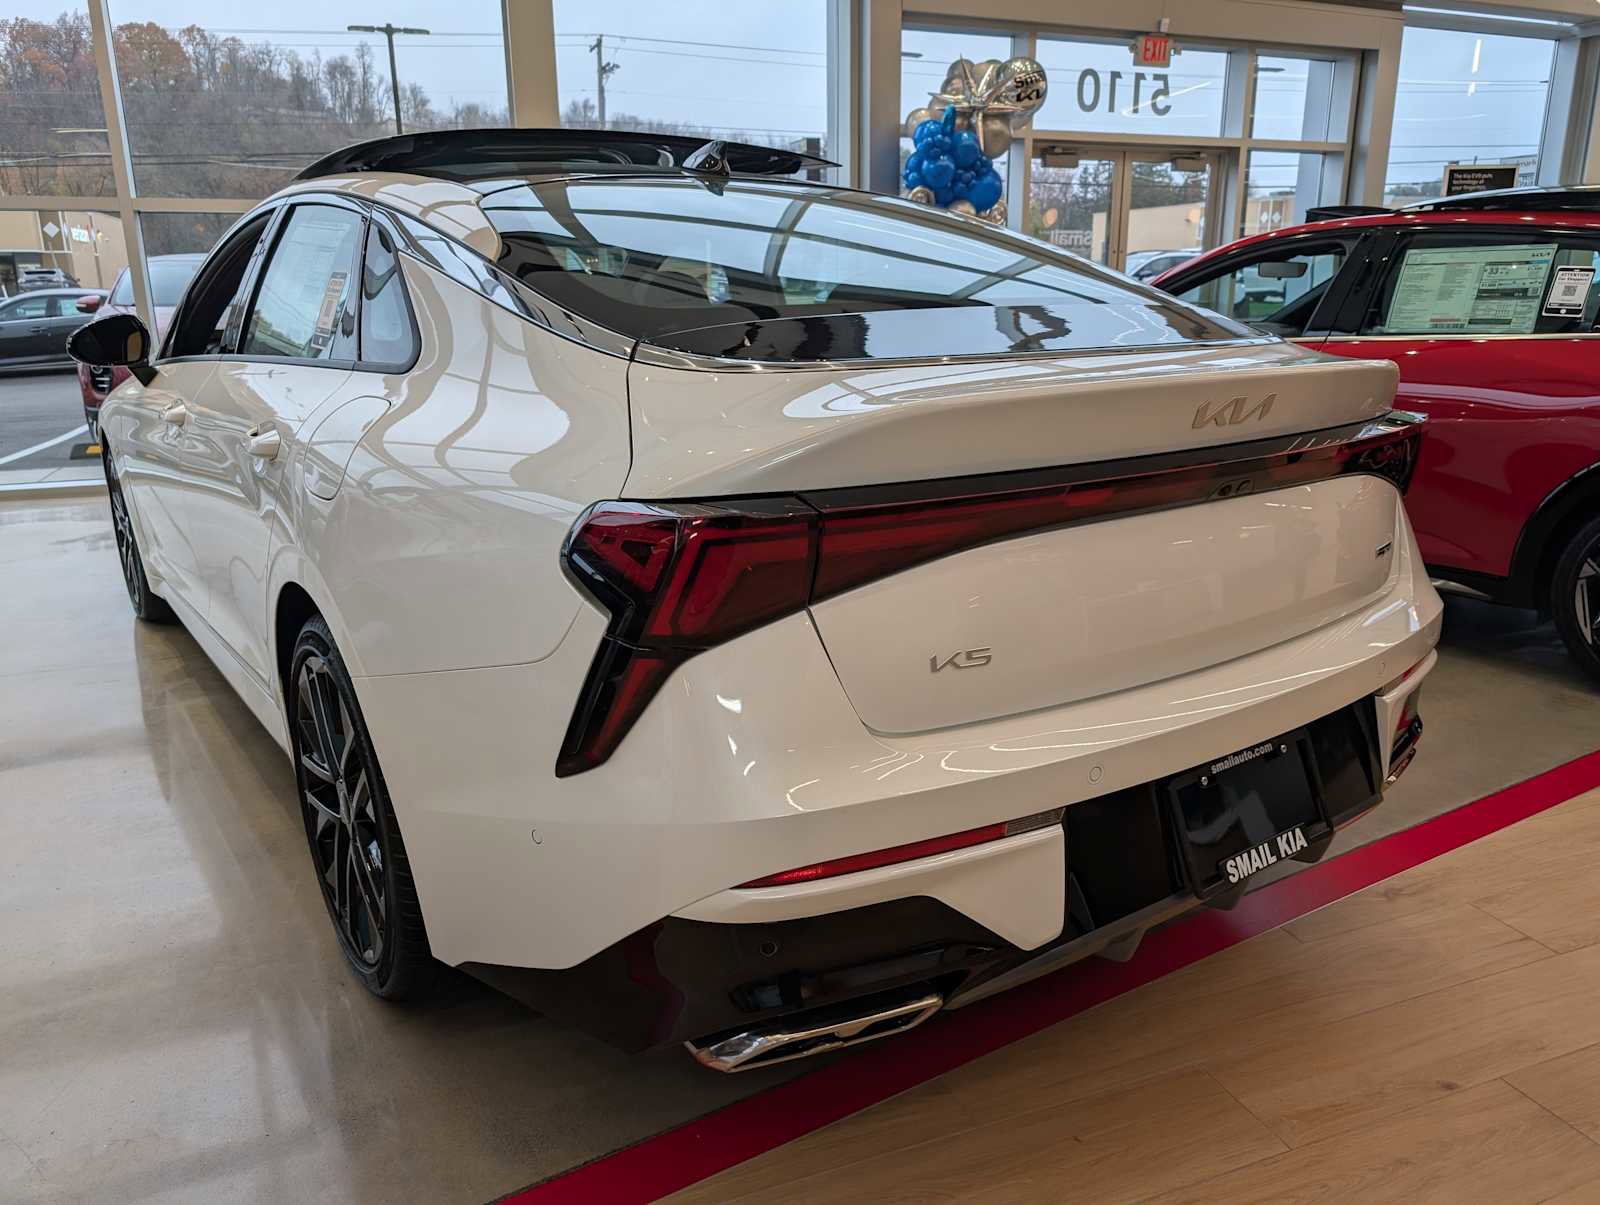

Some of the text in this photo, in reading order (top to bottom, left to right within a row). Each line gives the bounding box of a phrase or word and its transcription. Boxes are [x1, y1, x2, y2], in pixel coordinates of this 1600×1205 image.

[1143, 36, 1168, 63] EXIT
[930, 647, 992, 673] K5
[1226, 827, 1308, 884] SMAIL KIA
